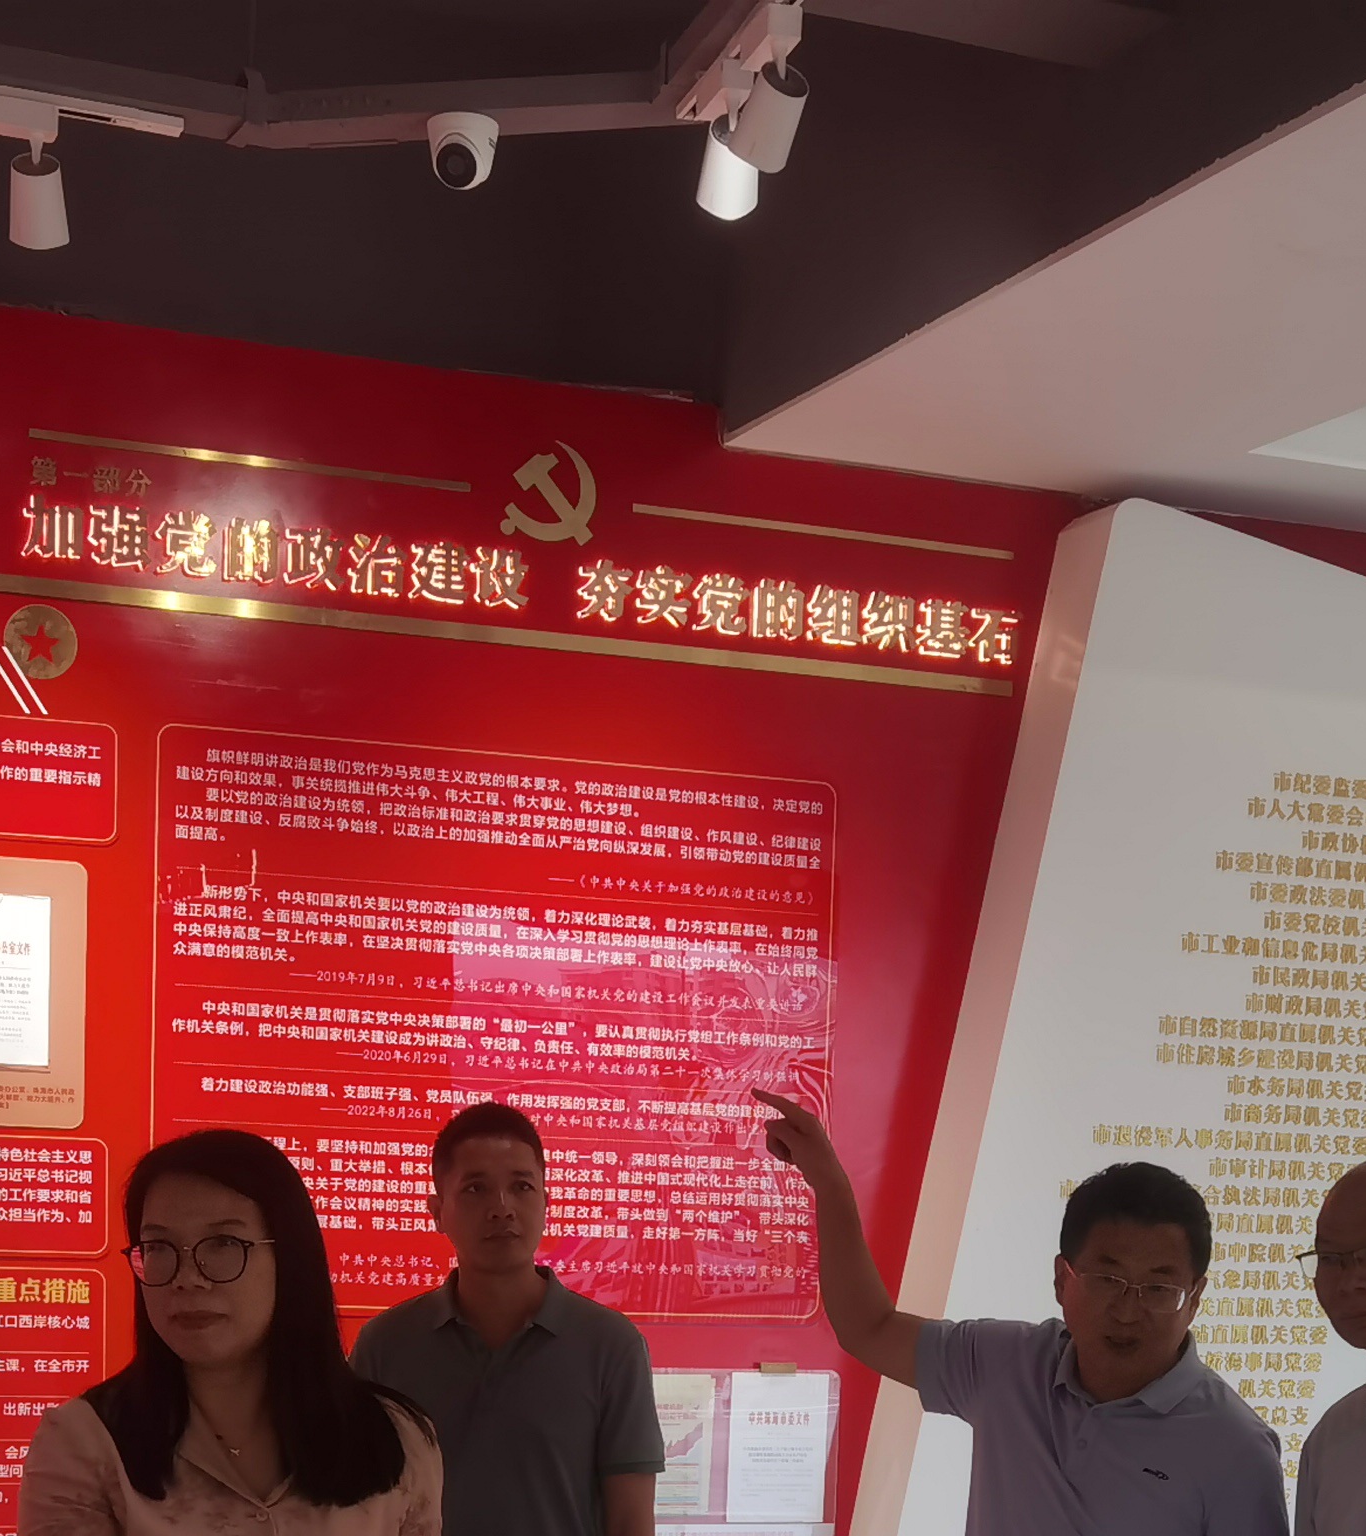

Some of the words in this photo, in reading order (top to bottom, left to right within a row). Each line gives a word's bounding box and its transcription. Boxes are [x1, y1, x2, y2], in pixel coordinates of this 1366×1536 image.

[30, 457, 152, 498] 第一部分
[21, 496, 529, 609] 加强党的政治建设
[576, 560, 1020, 666] 夯实党的组织基石
[175, 824, 227, 842] 面提高。
[173, 942, 296, 963] 众满意的模范机关。
[200, 1077, 785, 1119] 着力建设政治功能强、支部班子强、党员队伍强、作用发挥强的党支部，不断提高基层党的建设质
[263, 1136, 435, 1157] 程上，要坚持和加强党的
[546, 1186, 810, 1209] 我革命的重要思想，总结运用好贯彻落实中央
[1193, 1183, 1329, 1209] 合执法局机关
[544, 1205, 810, 1226] 制度改革，带头做到“两个维护”，带头深化
[1210, 1212, 1313, 1236] 局直属机关
[1211, 1242, 1316, 1268] 市中院机关
[1199, 1351, 1322, 1373] 桥海事局党委
[1238, 1378, 1316, 1399] 机关党委
